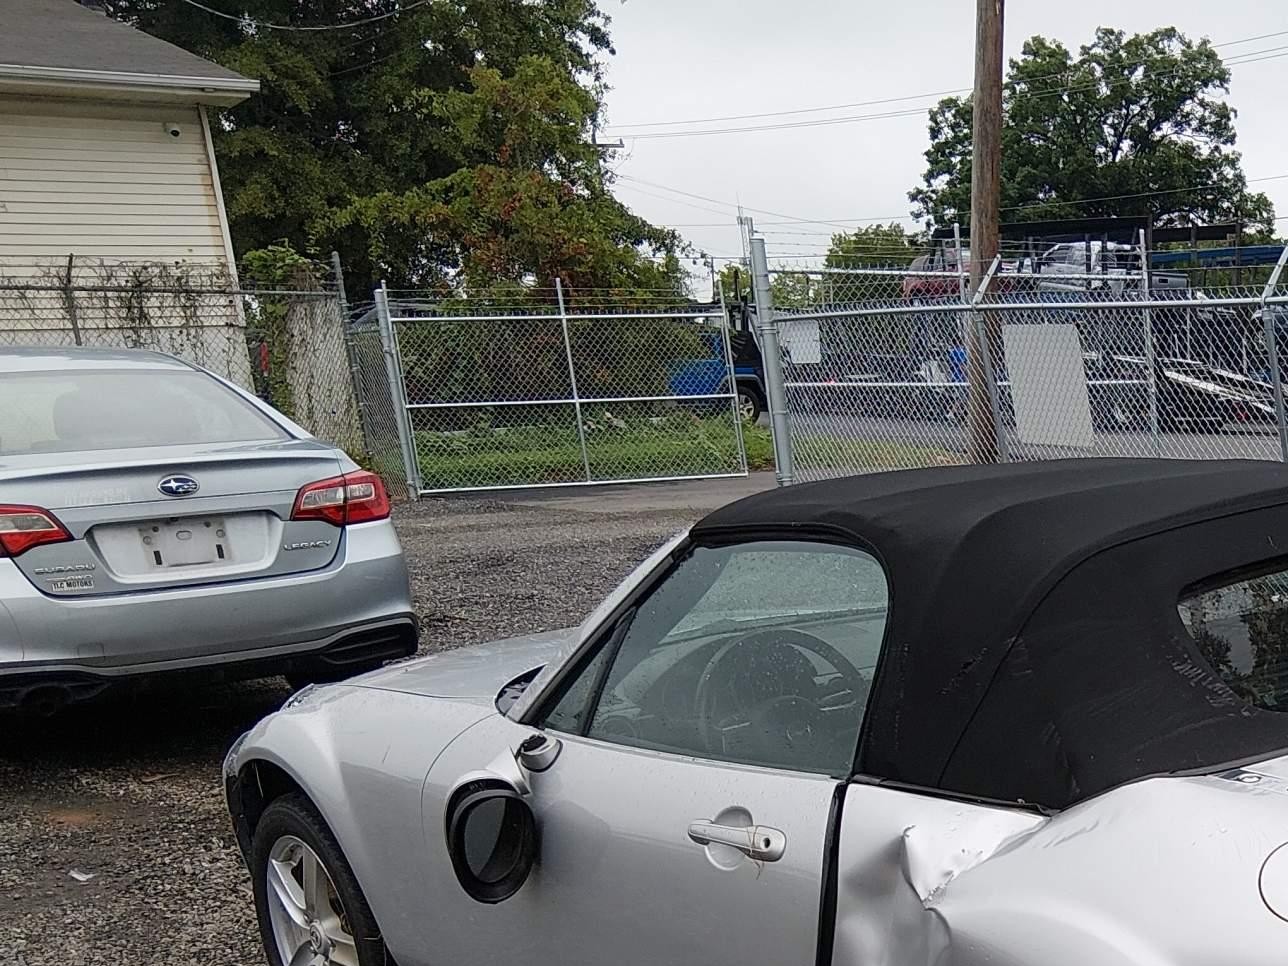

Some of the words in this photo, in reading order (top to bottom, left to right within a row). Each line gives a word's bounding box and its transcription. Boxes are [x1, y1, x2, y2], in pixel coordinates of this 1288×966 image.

[283, 539, 332, 551] LEGACY
[34, 563, 96, 575] SUBARU
[66, 580, 93, 588] MOTORS
